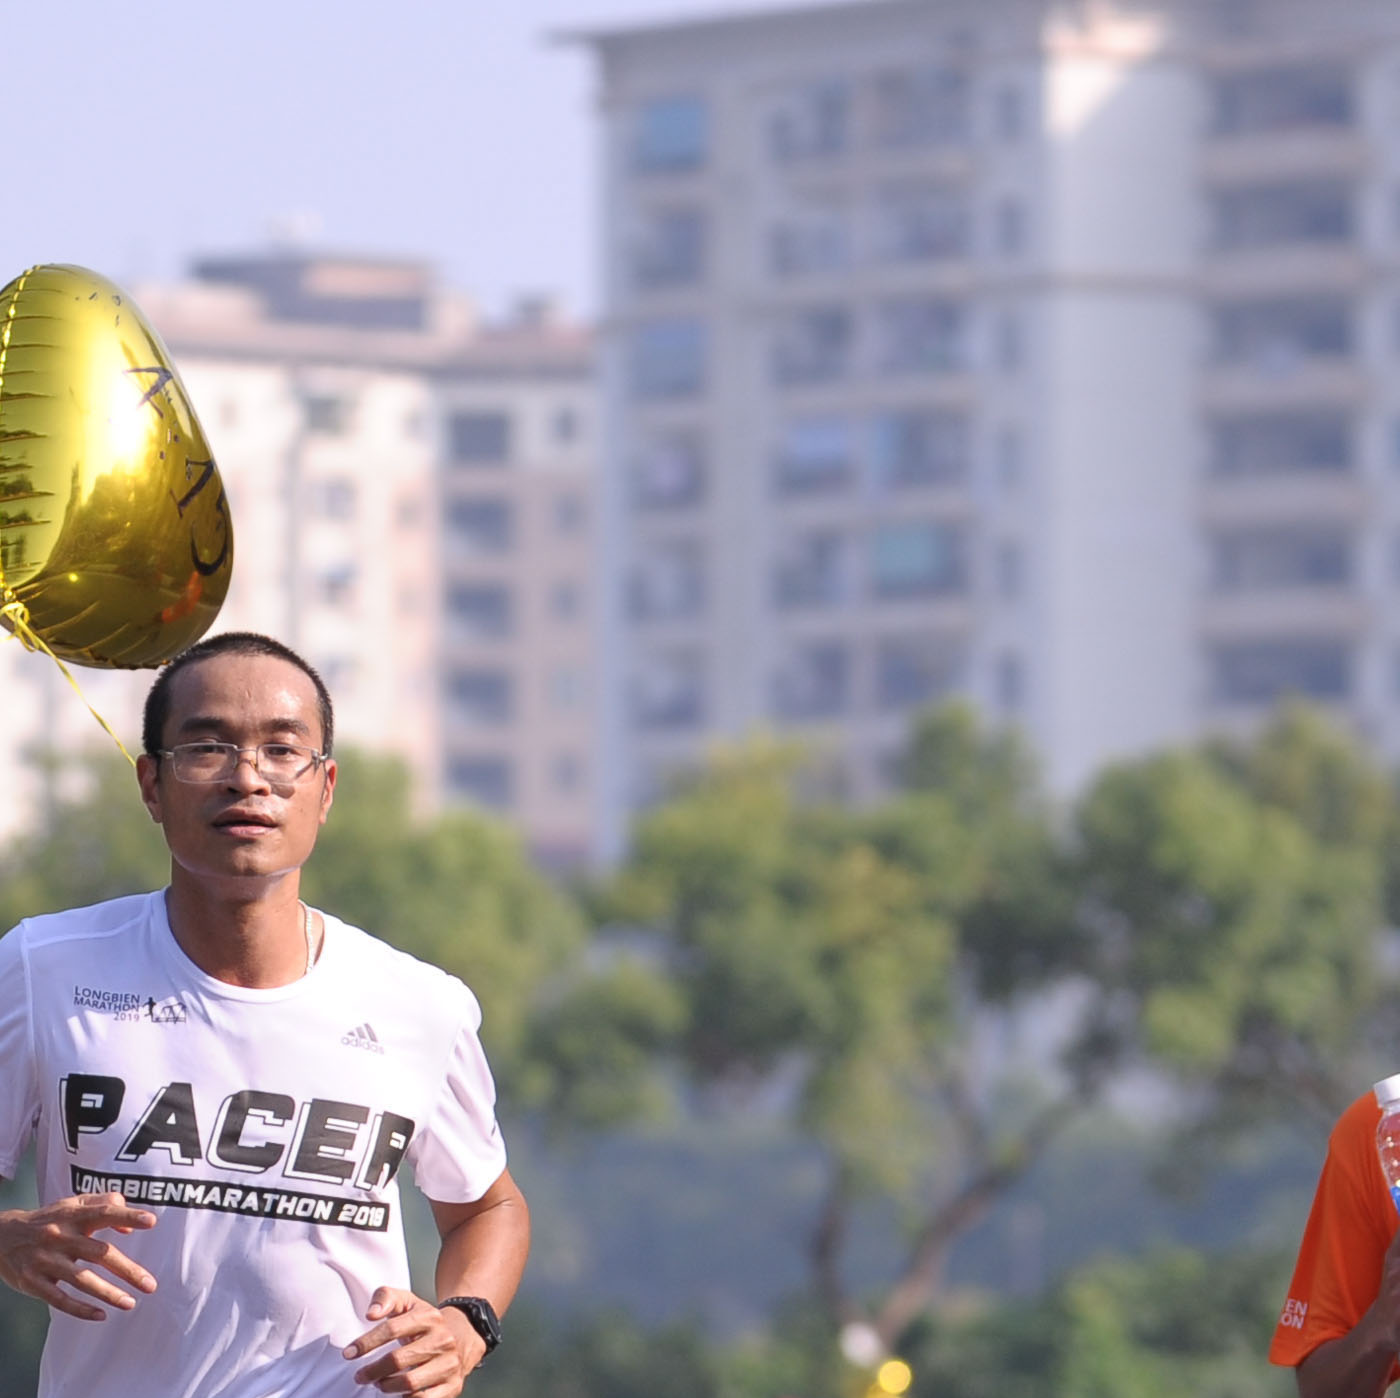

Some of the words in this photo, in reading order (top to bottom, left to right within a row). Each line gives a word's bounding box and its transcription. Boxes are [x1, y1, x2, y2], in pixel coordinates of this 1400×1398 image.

[74, 986, 140, 1004] LONGBIEN
[73, 997, 140, 1013] MARATHON
[113, 1012, 140, 1022] 2019
[340, 1036, 385, 1055] adidas
[59, 1073, 416, 1192] PACER
[76, 1172, 334, 1221] LONGBIENMARATHON
